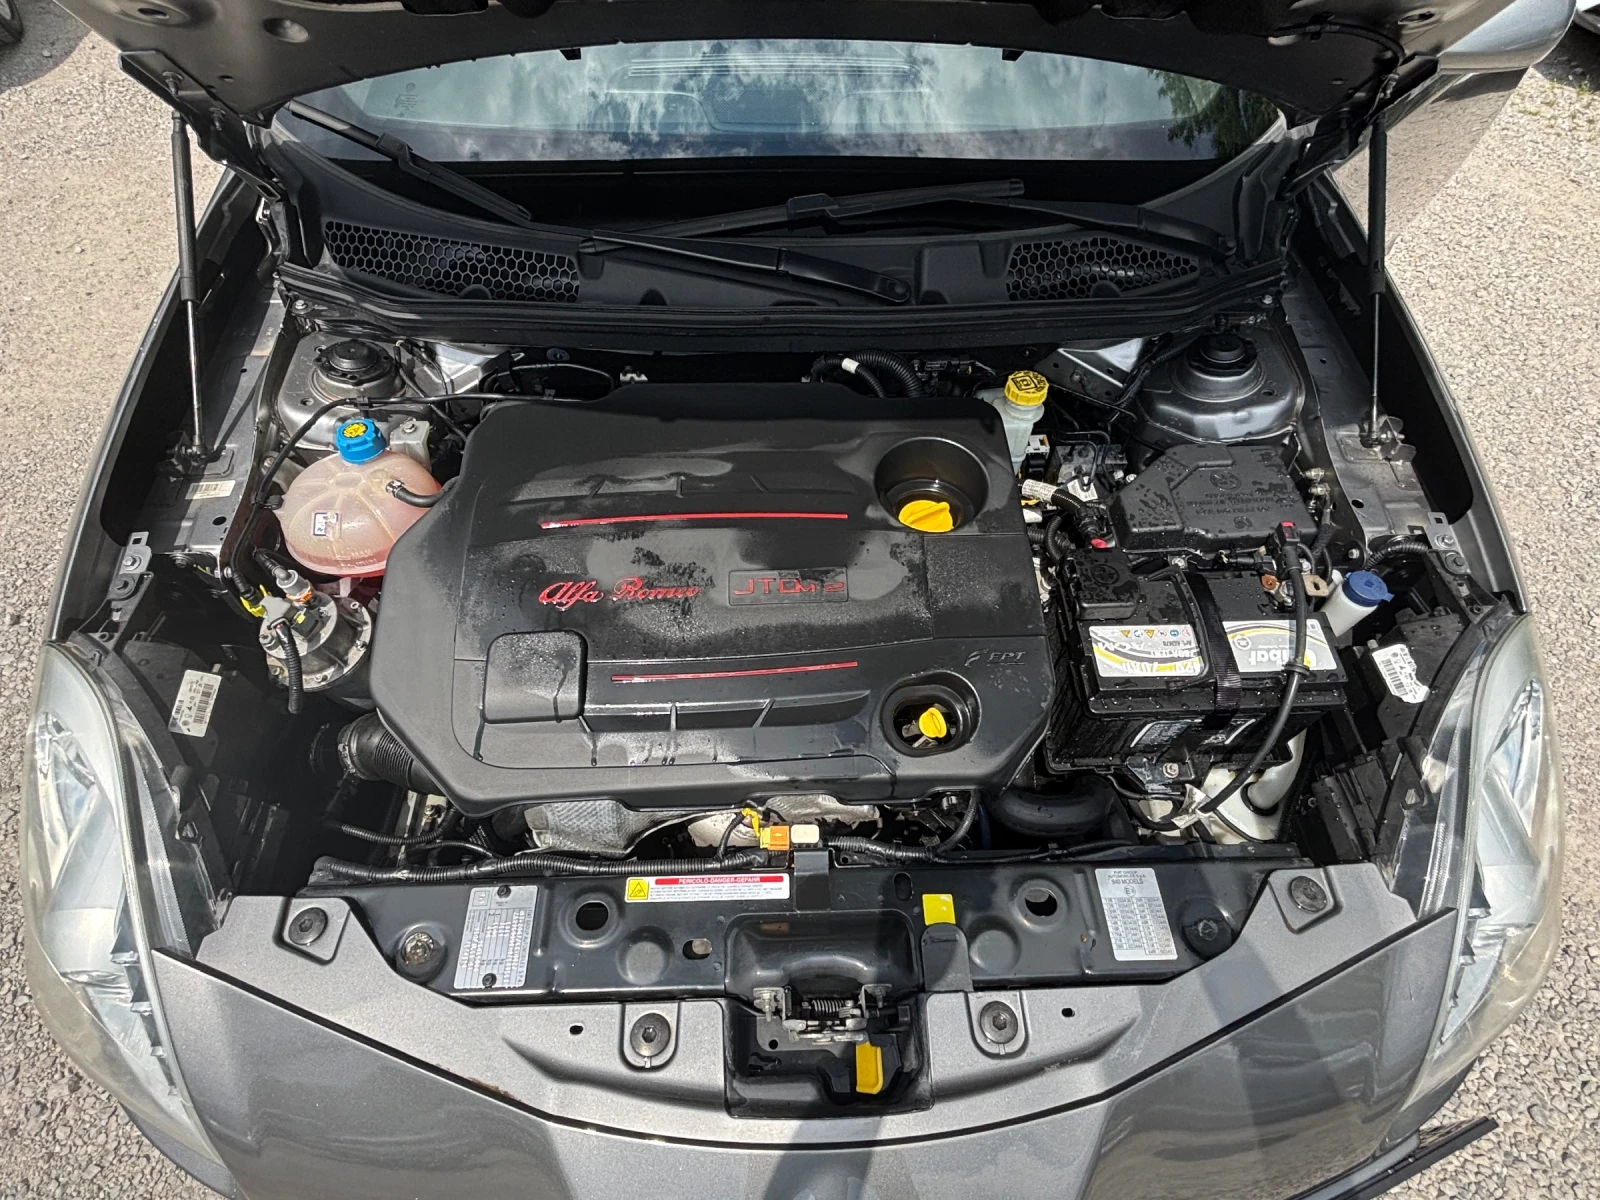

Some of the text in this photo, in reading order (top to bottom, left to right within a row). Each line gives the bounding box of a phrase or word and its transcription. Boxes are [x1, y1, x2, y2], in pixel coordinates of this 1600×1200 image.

[538, 576, 703, 611] Alfa Romeo
[1248, 647, 1317, 668] Uibat
